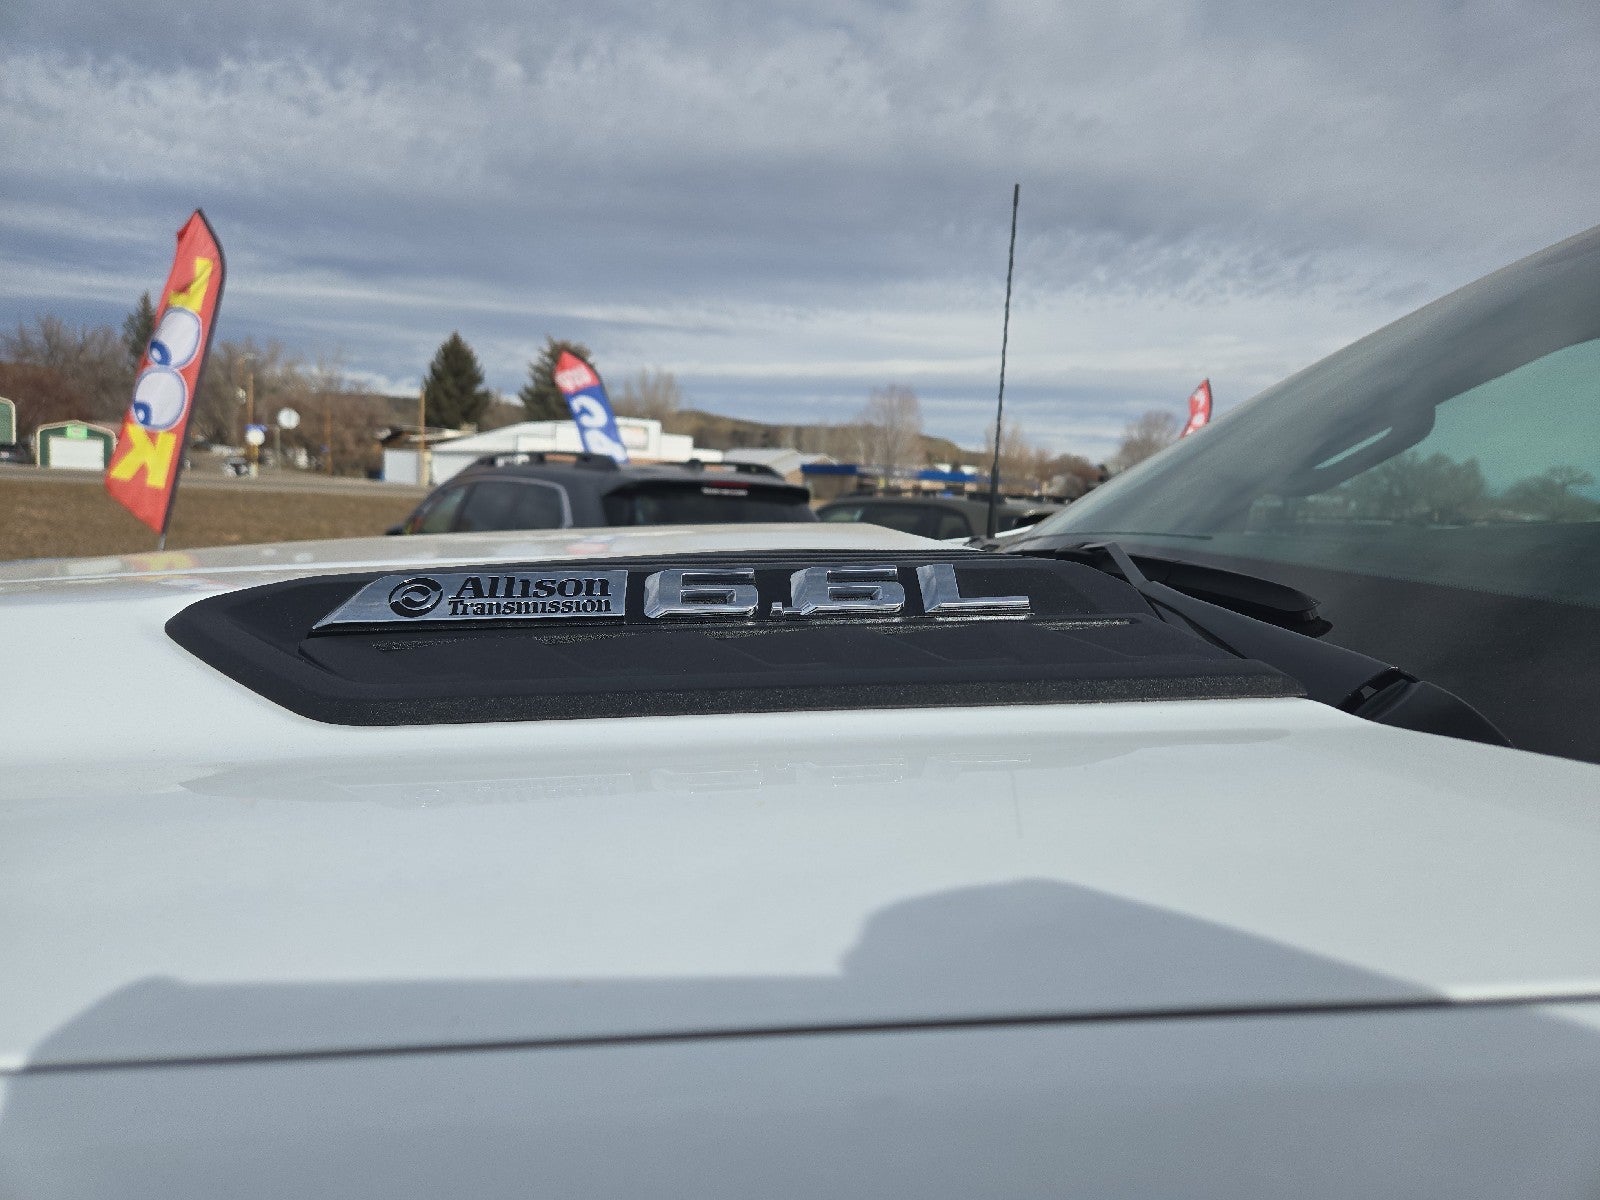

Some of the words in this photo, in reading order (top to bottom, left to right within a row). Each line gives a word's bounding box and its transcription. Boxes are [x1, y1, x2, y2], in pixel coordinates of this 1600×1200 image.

[449, 575, 612, 600] Allison
[643, 564, 1031, 619] 6.6L
[448, 598, 612, 616] Transmission
